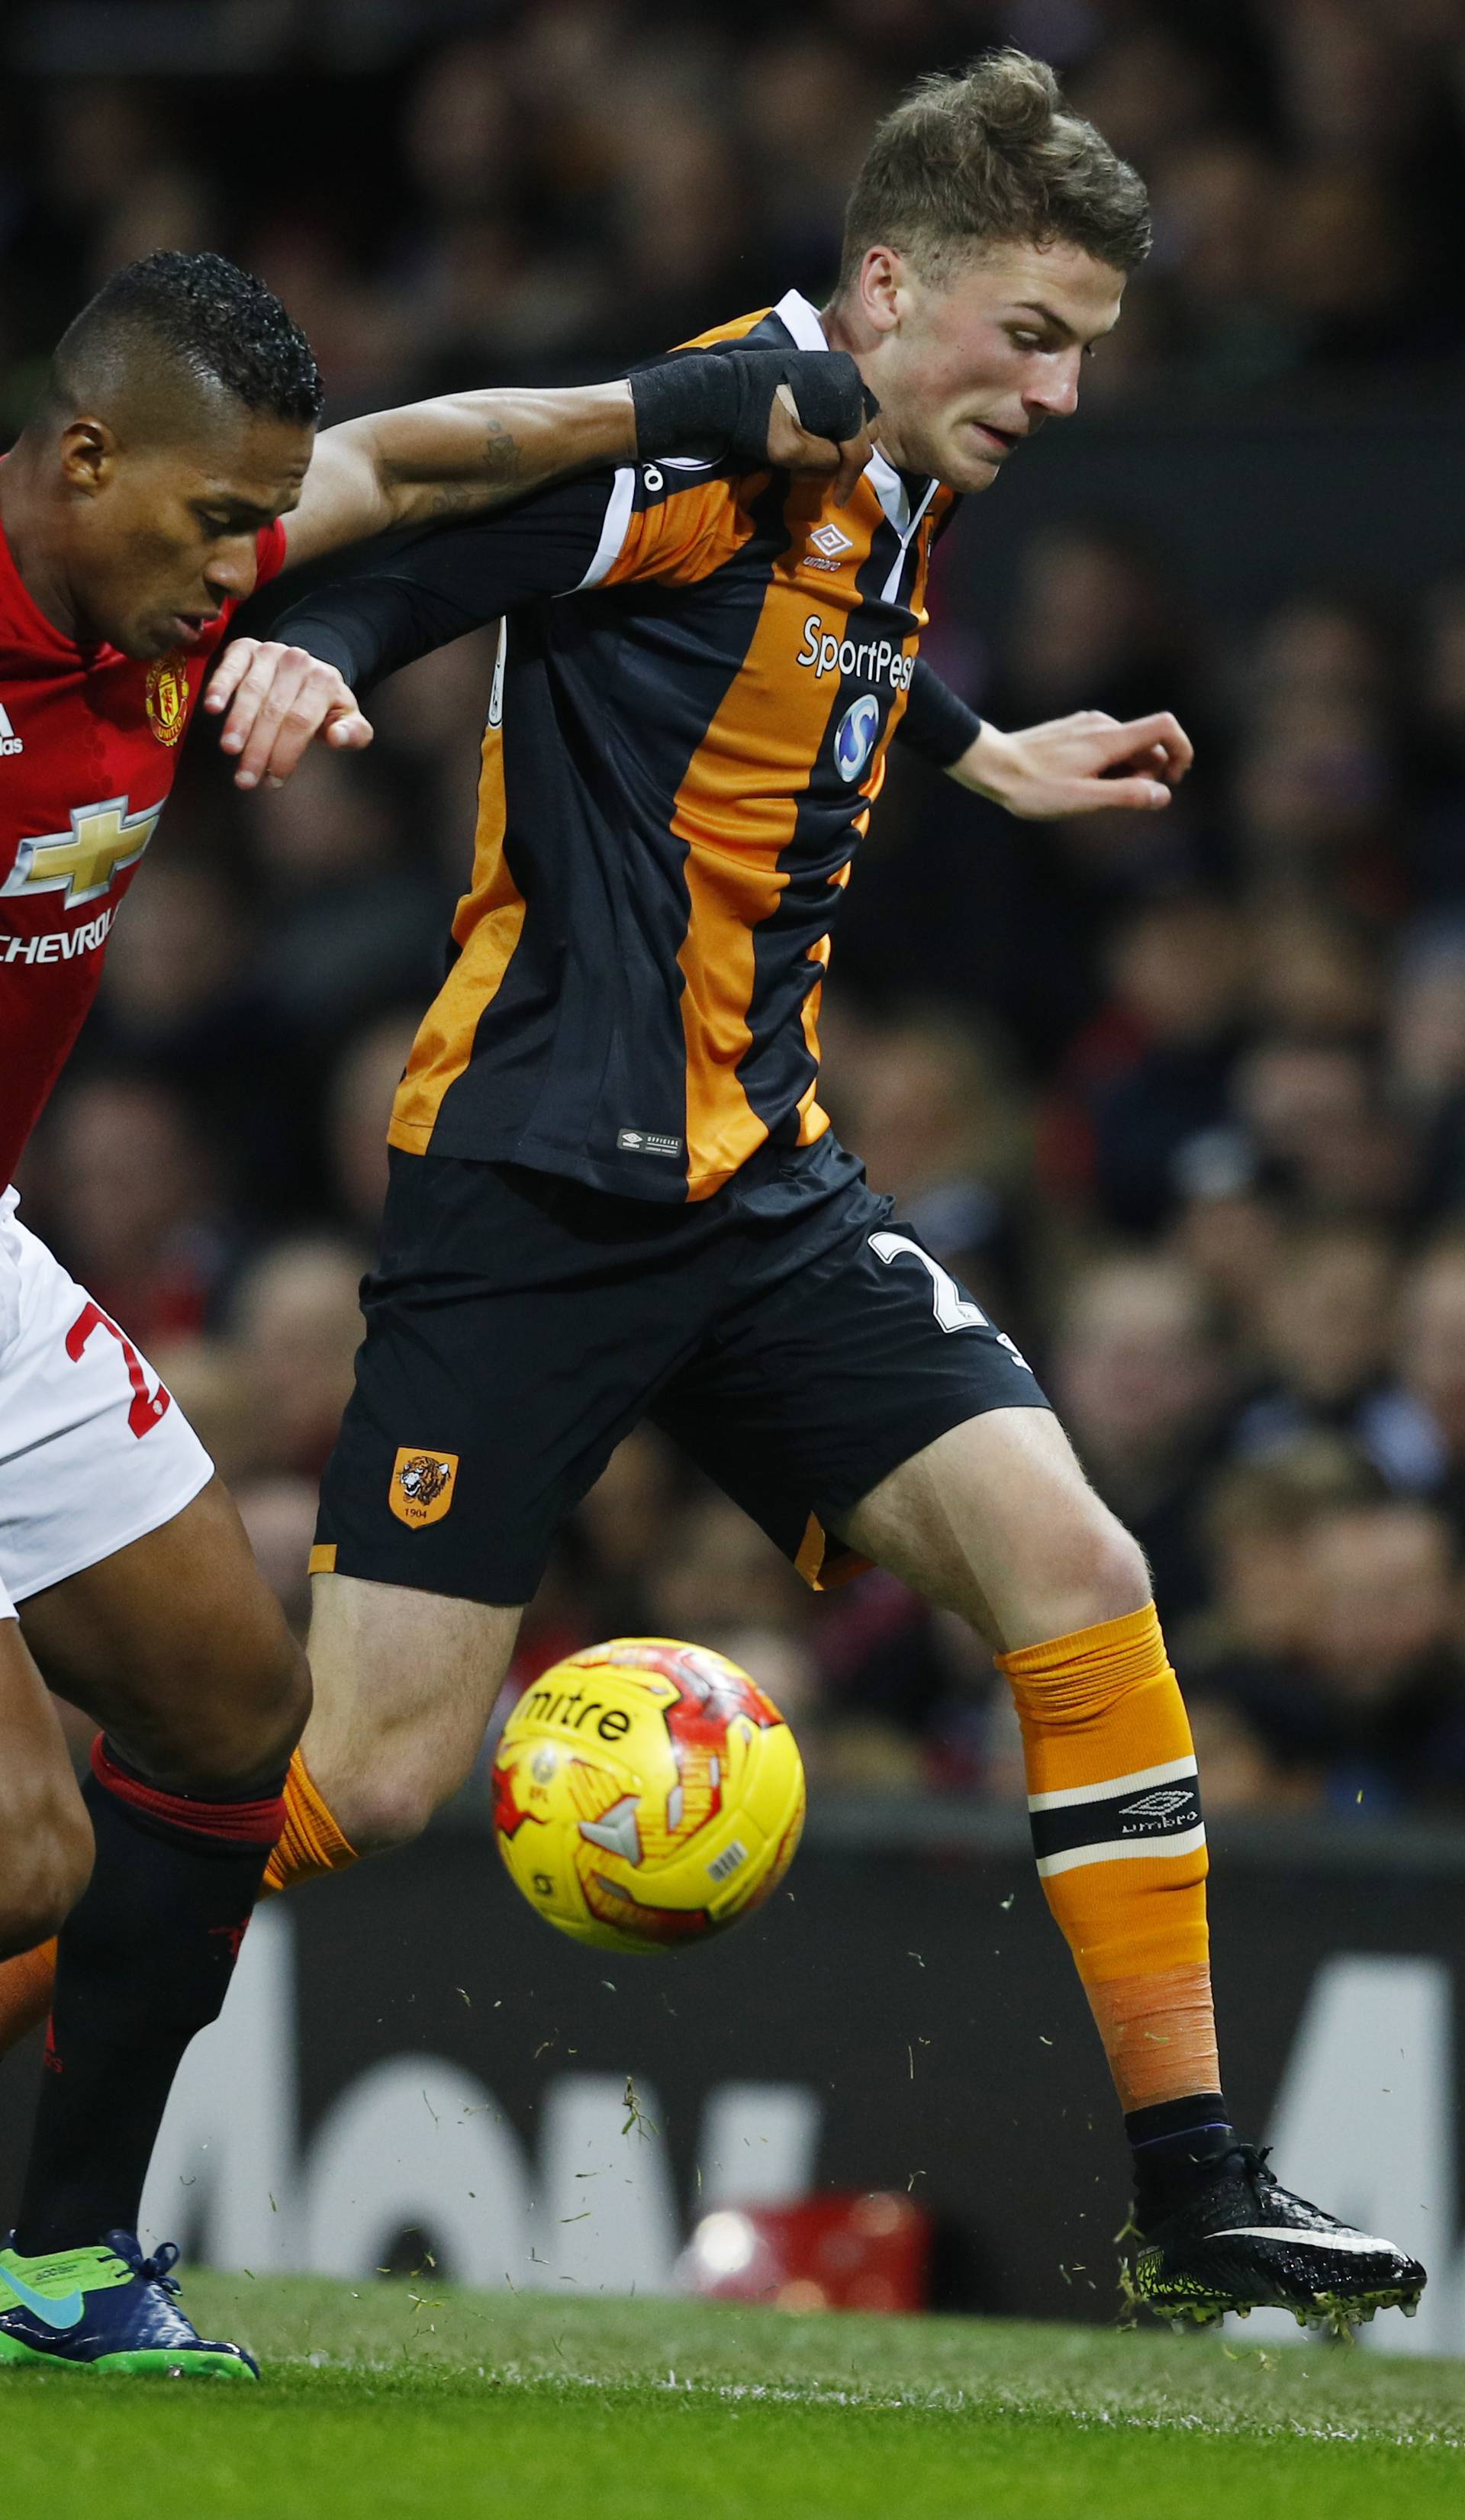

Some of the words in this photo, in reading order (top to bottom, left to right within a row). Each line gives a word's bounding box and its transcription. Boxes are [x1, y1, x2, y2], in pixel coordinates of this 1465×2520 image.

[803, 556, 841, 572] umbro
[647, 1136, 678, 1146] OFFICIAL
[404, 1508, 427, 1519] 1904
[1122, 1811, 1198, 1834] umbro
